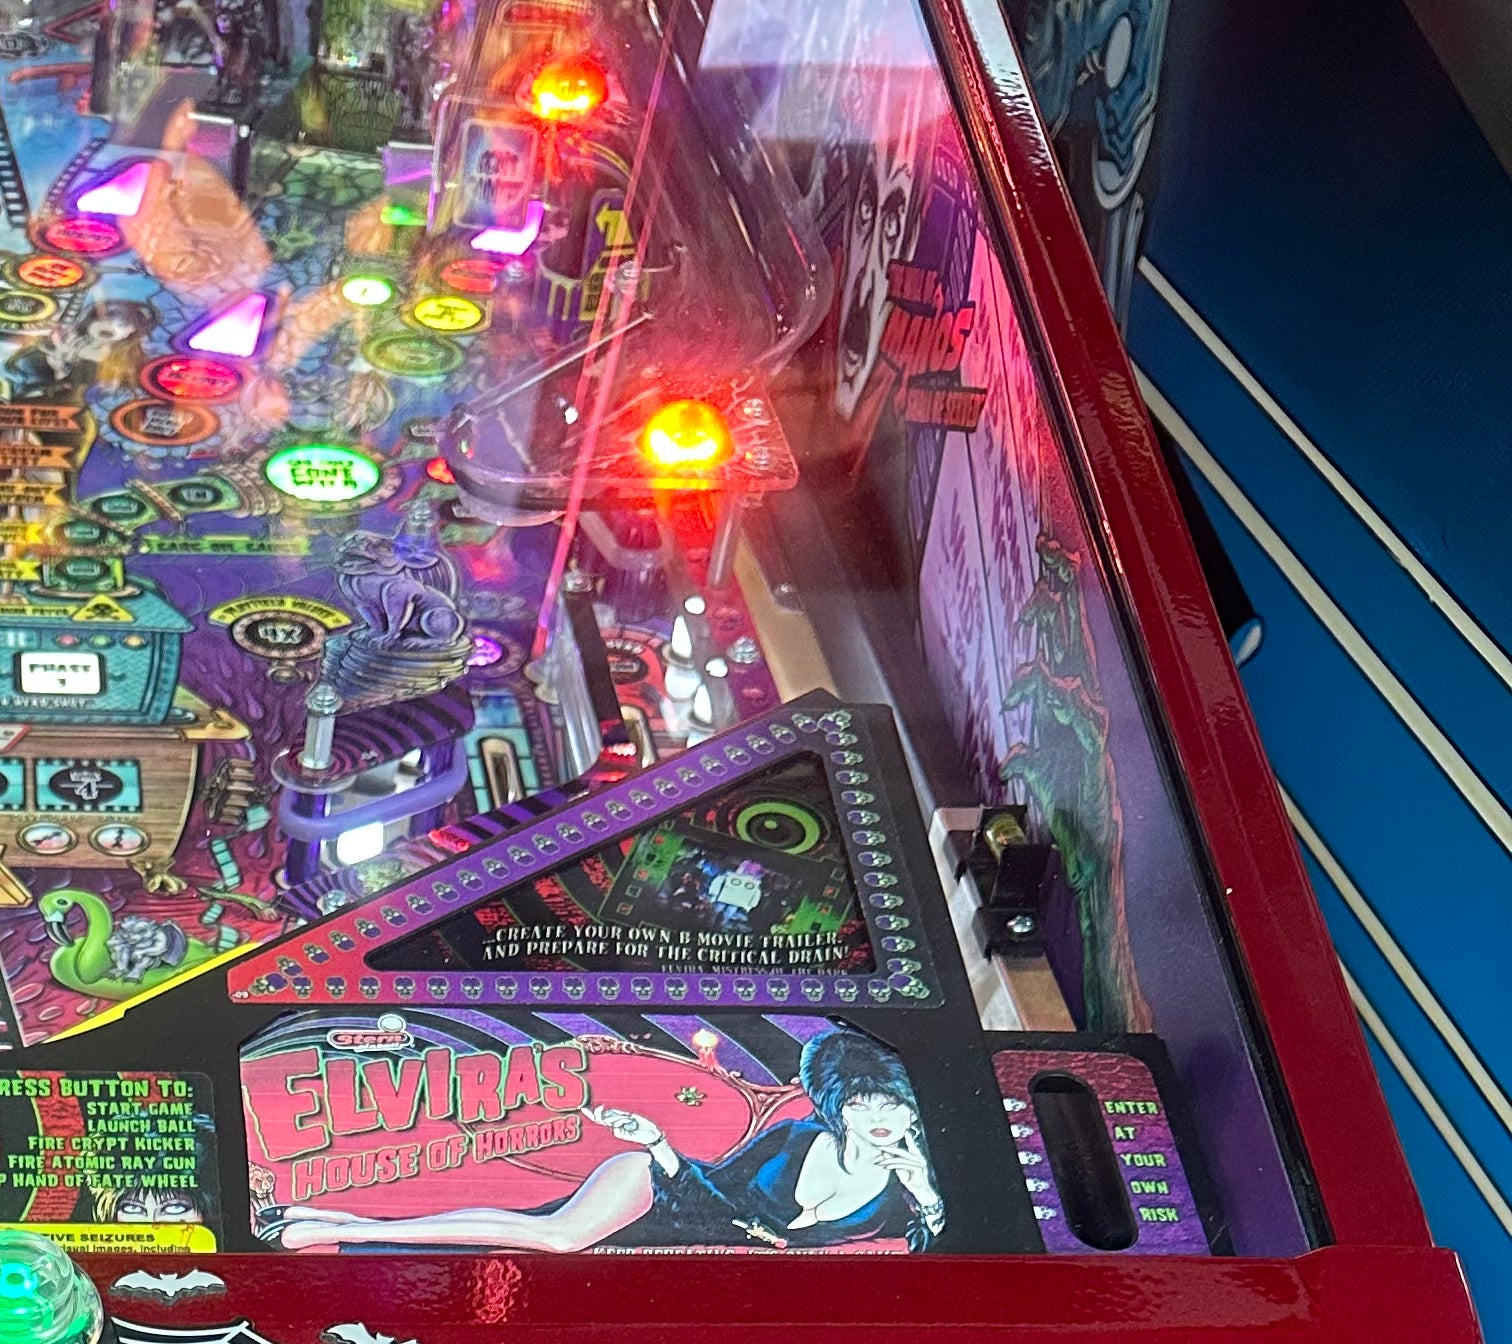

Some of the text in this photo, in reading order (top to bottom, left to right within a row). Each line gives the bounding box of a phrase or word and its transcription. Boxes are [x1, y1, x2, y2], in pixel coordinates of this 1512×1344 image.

[573, 925, 622, 940] YOUR
[628, 927, 671, 943] OWN
[697, 932, 754, 947] MOVIE
[482, 941, 849, 965] AND PREPARE FOR THE CRITICAL DRAIN!
[336, 1033, 403, 1046] Stern
[59, 1079, 150, 1098] BUTTON
[158, 1080, 194, 1097] TO:
[87, 1102, 194, 1115] START GAME
[240, 1043, 588, 1161] ELVIRA'S
[1104, 1101, 1159, 1114] ENTER
[88, 1119, 196, 1133] LAUNCH BALL
[1114, 1126, 1136, 1140] AT
[28, 1136, 196, 1151] FIRE CRYPT KICKER
[7, 1155, 197, 1170] FIRE ATOMIC RAY GUN
[293, 1116, 583, 1201] HOUSE OF HORRORS
[1119, 1153, 1167, 1167] YOUR
[13, 1172, 59, 1188] HAND
[64, 1173, 84, 1188] OF
[90, 1172, 135, 1188] FATE
[141, 1172, 199, 1188] WHEEL
[1130, 1181, 1169, 1194] OWN
[1138, 1207, 1179, 1221] RISK
[79, 1233, 156, 1243] SEIZURES
